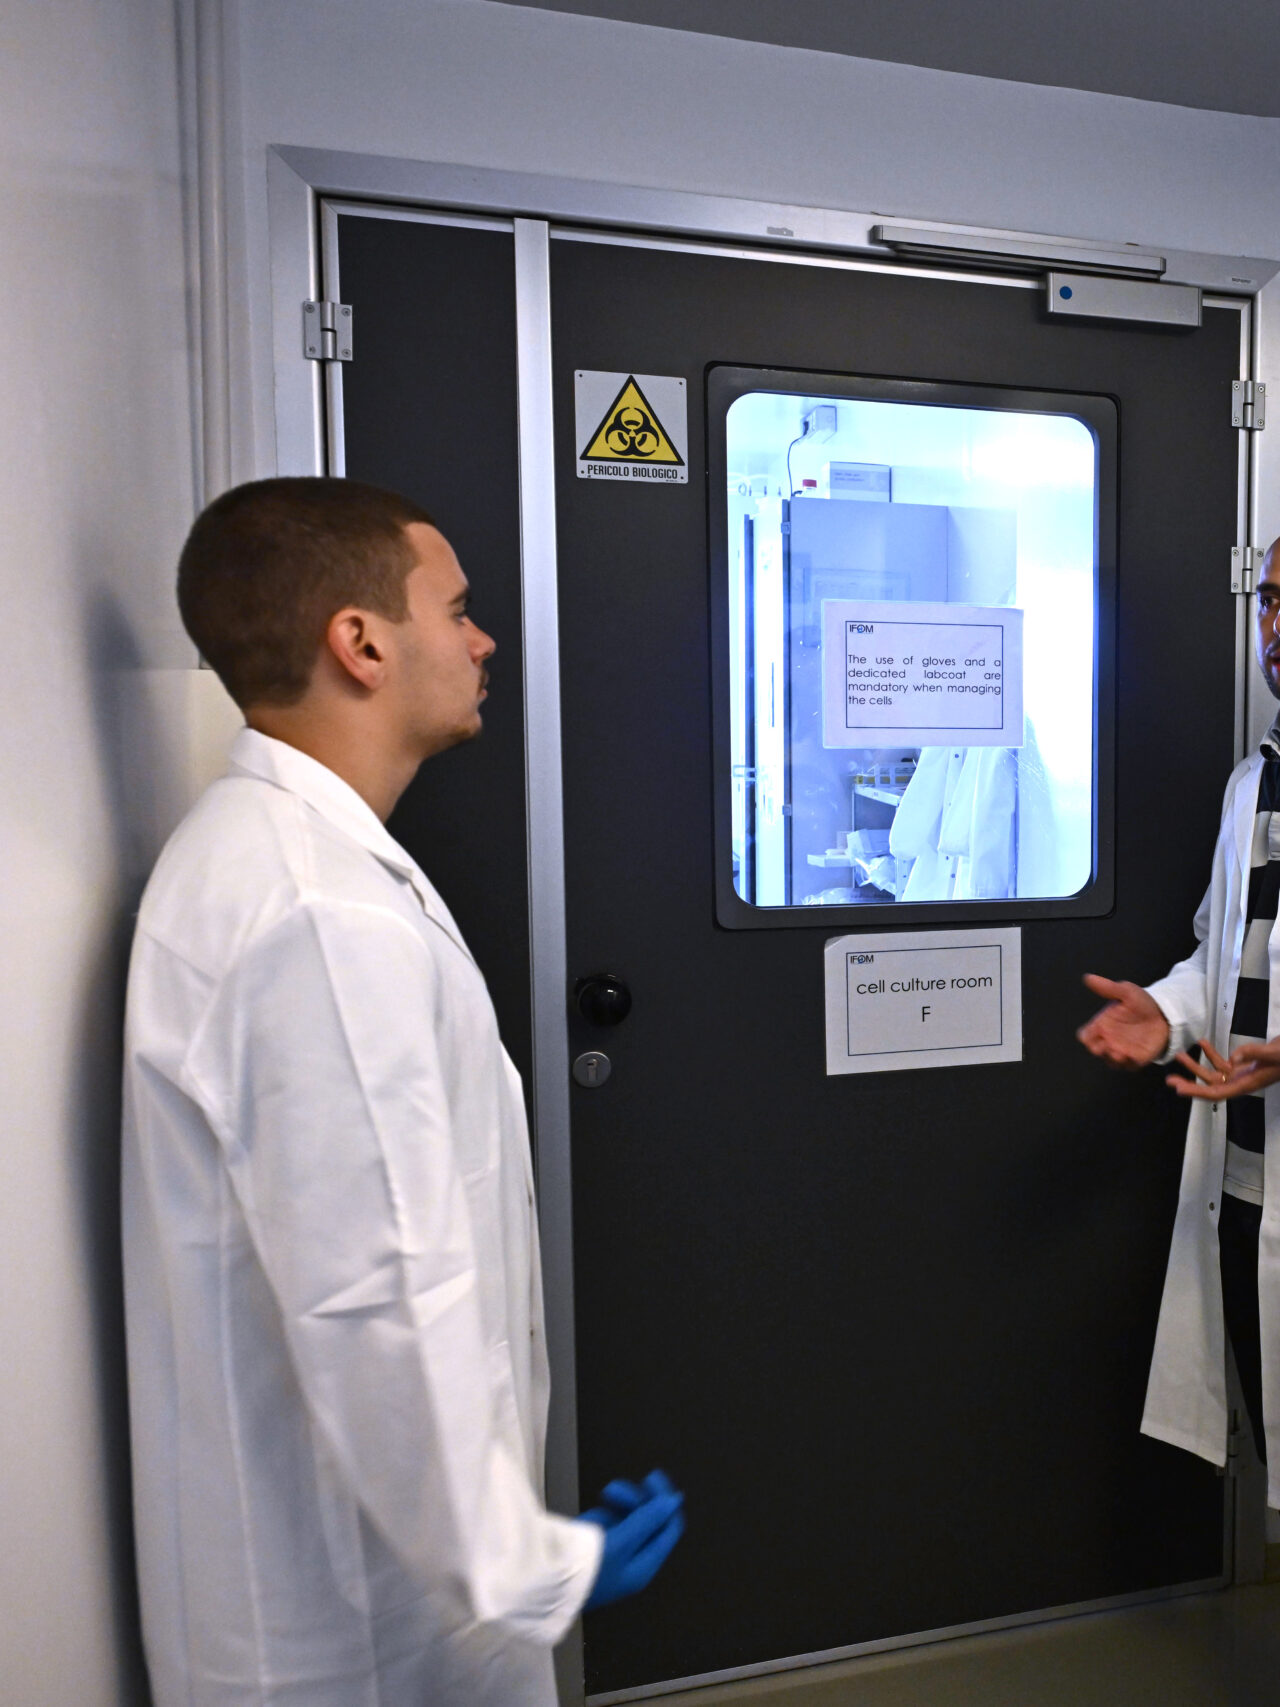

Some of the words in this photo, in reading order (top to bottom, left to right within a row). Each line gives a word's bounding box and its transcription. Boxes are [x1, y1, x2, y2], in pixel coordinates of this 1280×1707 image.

[587, 464, 630, 476] PERICOLO
[632, 467, 678, 479] BIOLOGICO
[849, 624, 874, 633] IFOM
[848, 654, 867, 665] The
[875, 656, 894, 665] use
[902, 655, 914, 665] of
[921, 656, 956, 668] gloves
[964, 657, 986, 667] and
[993, 659, 1001, 667] a
[848, 668, 906, 679] dedicated
[923, 669, 967, 680] labcoat
[983, 671, 1001, 680] are
[848, 682, 909, 694] mandatory
[912, 683, 943, 693] when
[947, 684, 1001, 696] managing
[848, 695, 866, 705] the
[868, 695, 893, 705] cells
[850, 954, 874, 964] IFOM
[856, 979, 885, 994] cell
[890, 977, 946, 992] culture
[950, 975, 993, 989] room
[921, 1006, 931, 1022] F
